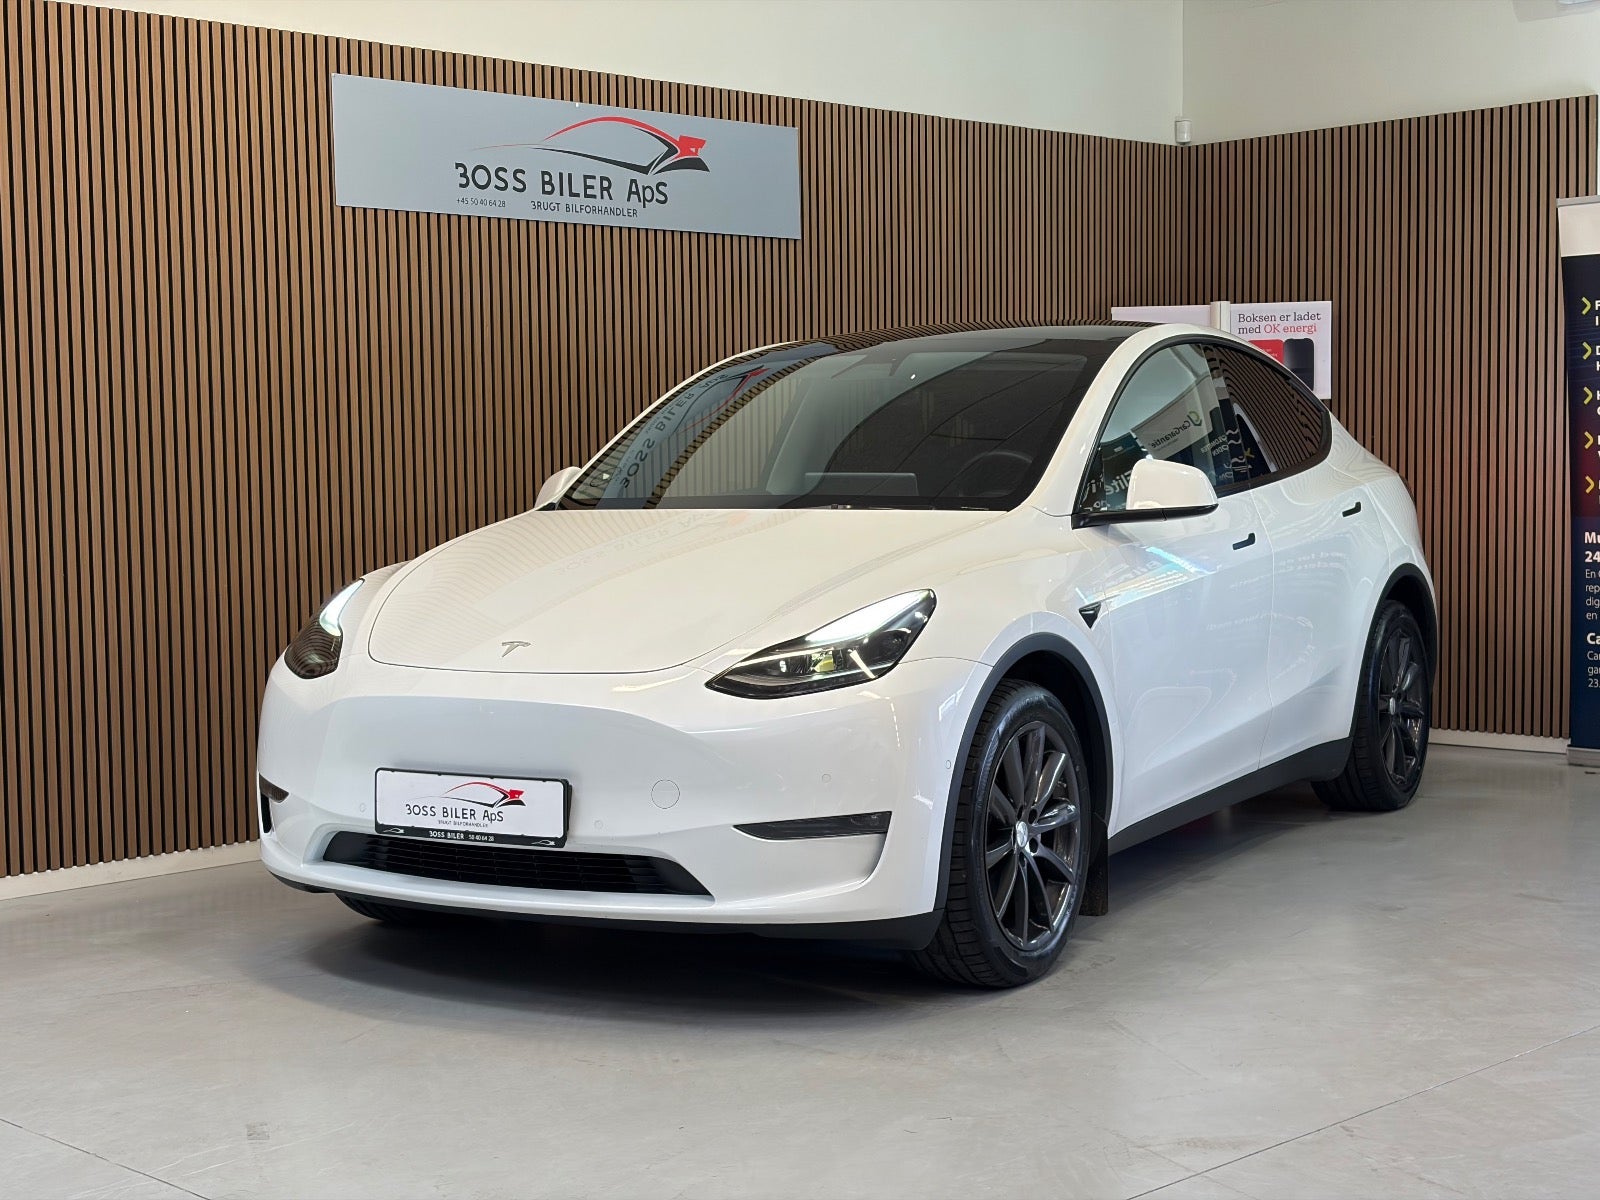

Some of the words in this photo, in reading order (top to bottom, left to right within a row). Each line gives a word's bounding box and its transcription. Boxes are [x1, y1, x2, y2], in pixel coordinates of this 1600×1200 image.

[540, 170, 613, 200] BILER
[626, 178, 668, 208] ApS
[566, 203, 638, 218] BILFORHANDLER
[1238, 312, 1277, 322] Boksen
[1280, 314, 1290, 322] er
[1293, 311, 1321, 321] ladet
[1238, 324, 1261, 334] med
[1264, 324, 1280, 333] OK
[1283, 323, 1316, 334] energi
[1586, 569, 1596, 578] En
[1586, 612, 1598, 620] en
[442, 807, 476, 820] BILER
[483, 810, 504, 824] ApS
